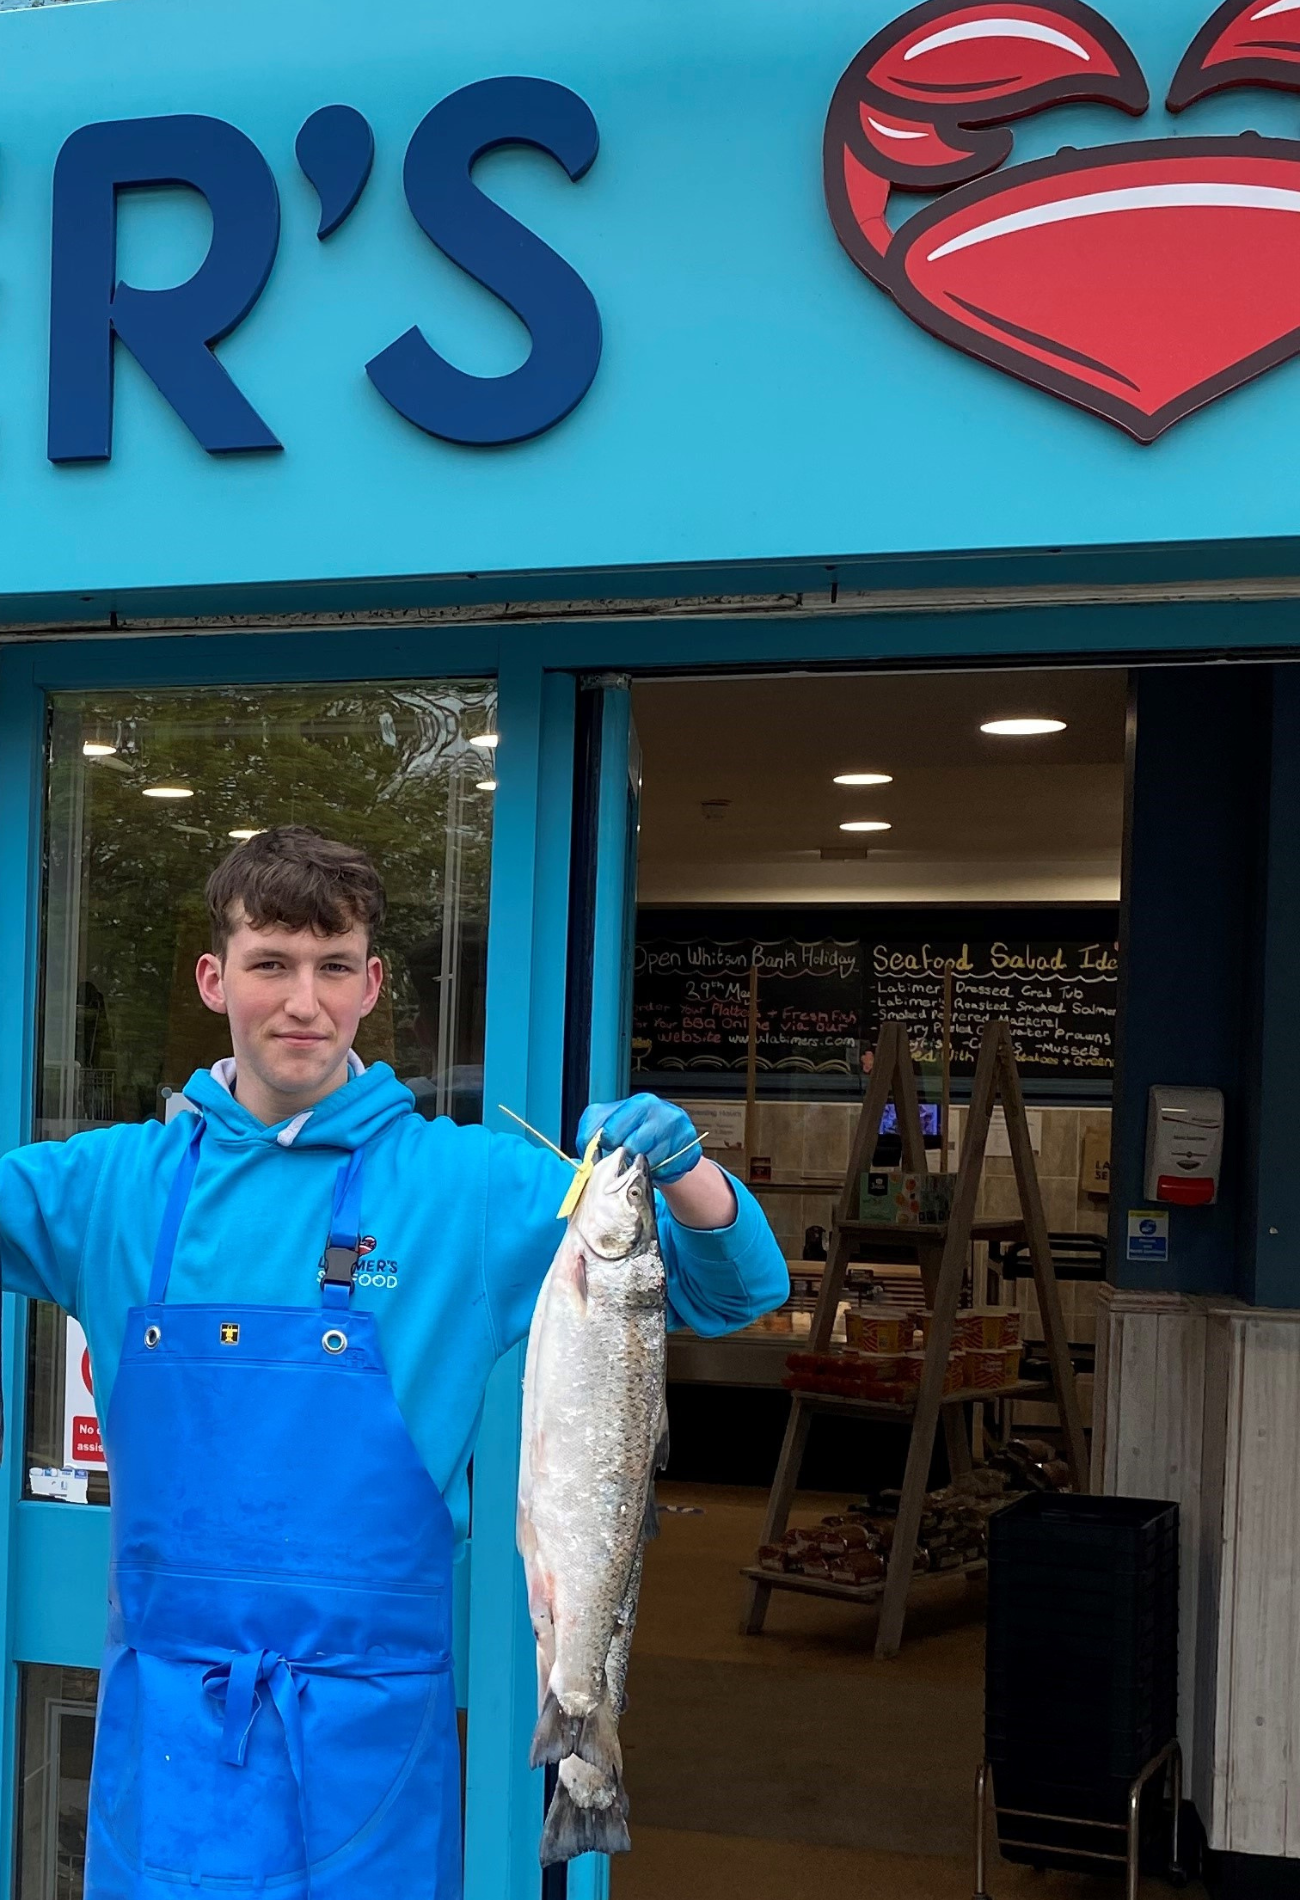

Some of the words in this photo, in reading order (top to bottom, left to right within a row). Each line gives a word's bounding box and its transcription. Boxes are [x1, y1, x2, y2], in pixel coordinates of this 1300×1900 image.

[752, 945, 797, 969] Bank
[802, 945, 859, 978] Holiday
[873, 943, 973, 971] Seafood
[990, 942, 1067, 970] Salad
[956, 981, 1014, 998] Dressed
[1021, 985, 1052, 998] Crab
[1059, 985, 1084, 999] Tub
[634, 1002, 671, 1012] rder
[712, 1003, 761, 1017] Plattes
[782, 1006, 828, 1021] Fresh
[954, 998, 1011, 1011] Roasted
[1016, 1001, 1067, 1014] Smoked
[682, 1017, 716, 1029] BBQ
[721, 1018, 770, 1030] Onlne
[931, 1010, 990, 1023] Pepered
[1055, 1028, 1111, 1045] Prawns
[317, 1256, 398, 1274] LMER'S
[79, 1424, 95, 1435] No
